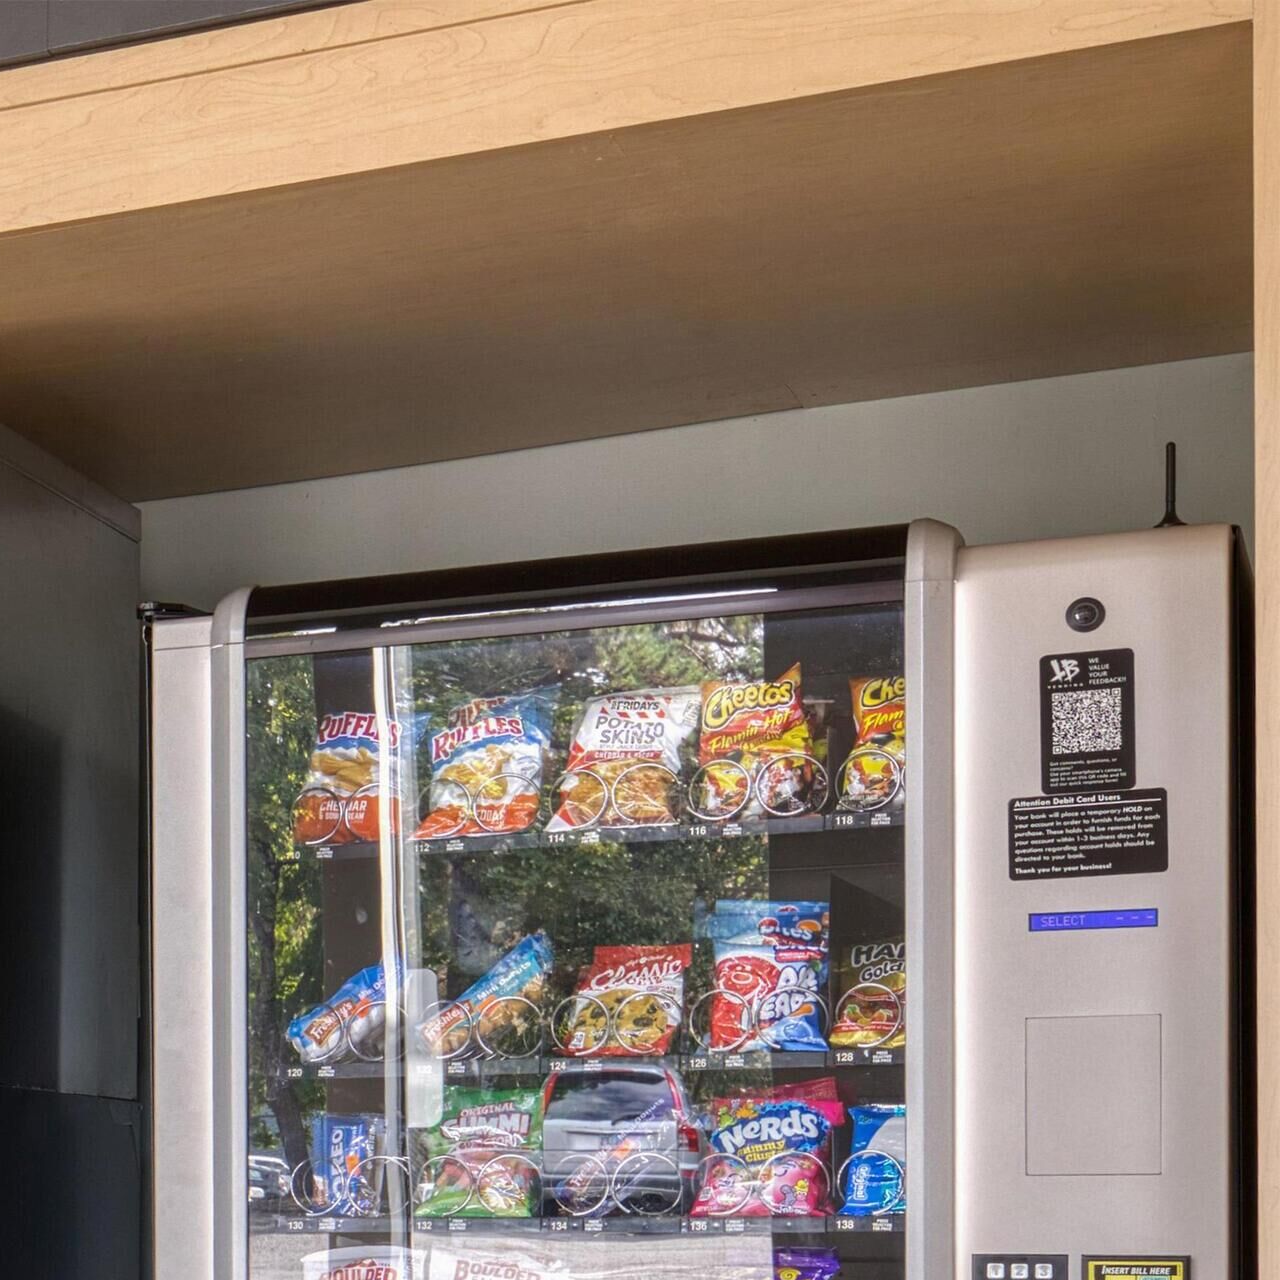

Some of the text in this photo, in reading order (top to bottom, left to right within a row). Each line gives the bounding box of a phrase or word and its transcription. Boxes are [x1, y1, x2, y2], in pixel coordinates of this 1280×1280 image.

[1088, 663, 1110, 671] VALUE
[1088, 670, 1108, 678] YOUR
[616, 700, 661, 710] FRIDAYS
[704, 680, 794, 730] Cheetos
[763, 708, 794, 729] Hot
[317, 711, 403, 746] RUFFLS
[595, 715, 666, 740] POTATO
[431, 715, 525, 763] RUFFLES
[599, 729, 657, 746] SKINS
[1014, 793, 1121, 808] Attention Debit Card Users
[835, 815, 854, 826] 118
[690, 826, 707, 836] 116
[548, 833, 565, 844] 114
[1040, 914, 1086, 928] SELECT
[835, 1052, 854, 1062] 128
[550, 1061, 567, 1071] 124
[690, 1058, 707, 1068] 126
[287, 1067, 303, 1077] 120
[460, 1102, 516, 1118] ORIGINAL
[288, 1221, 304, 1231] 130
[416, 1221, 433, 1231] 132
[551, 1221, 568, 1231] 134
[690, 1221, 708, 1231] 136
[836, 1219, 855, 1230] 138
[1101, 1265, 1172, 1275] INSERT BILL HERE
